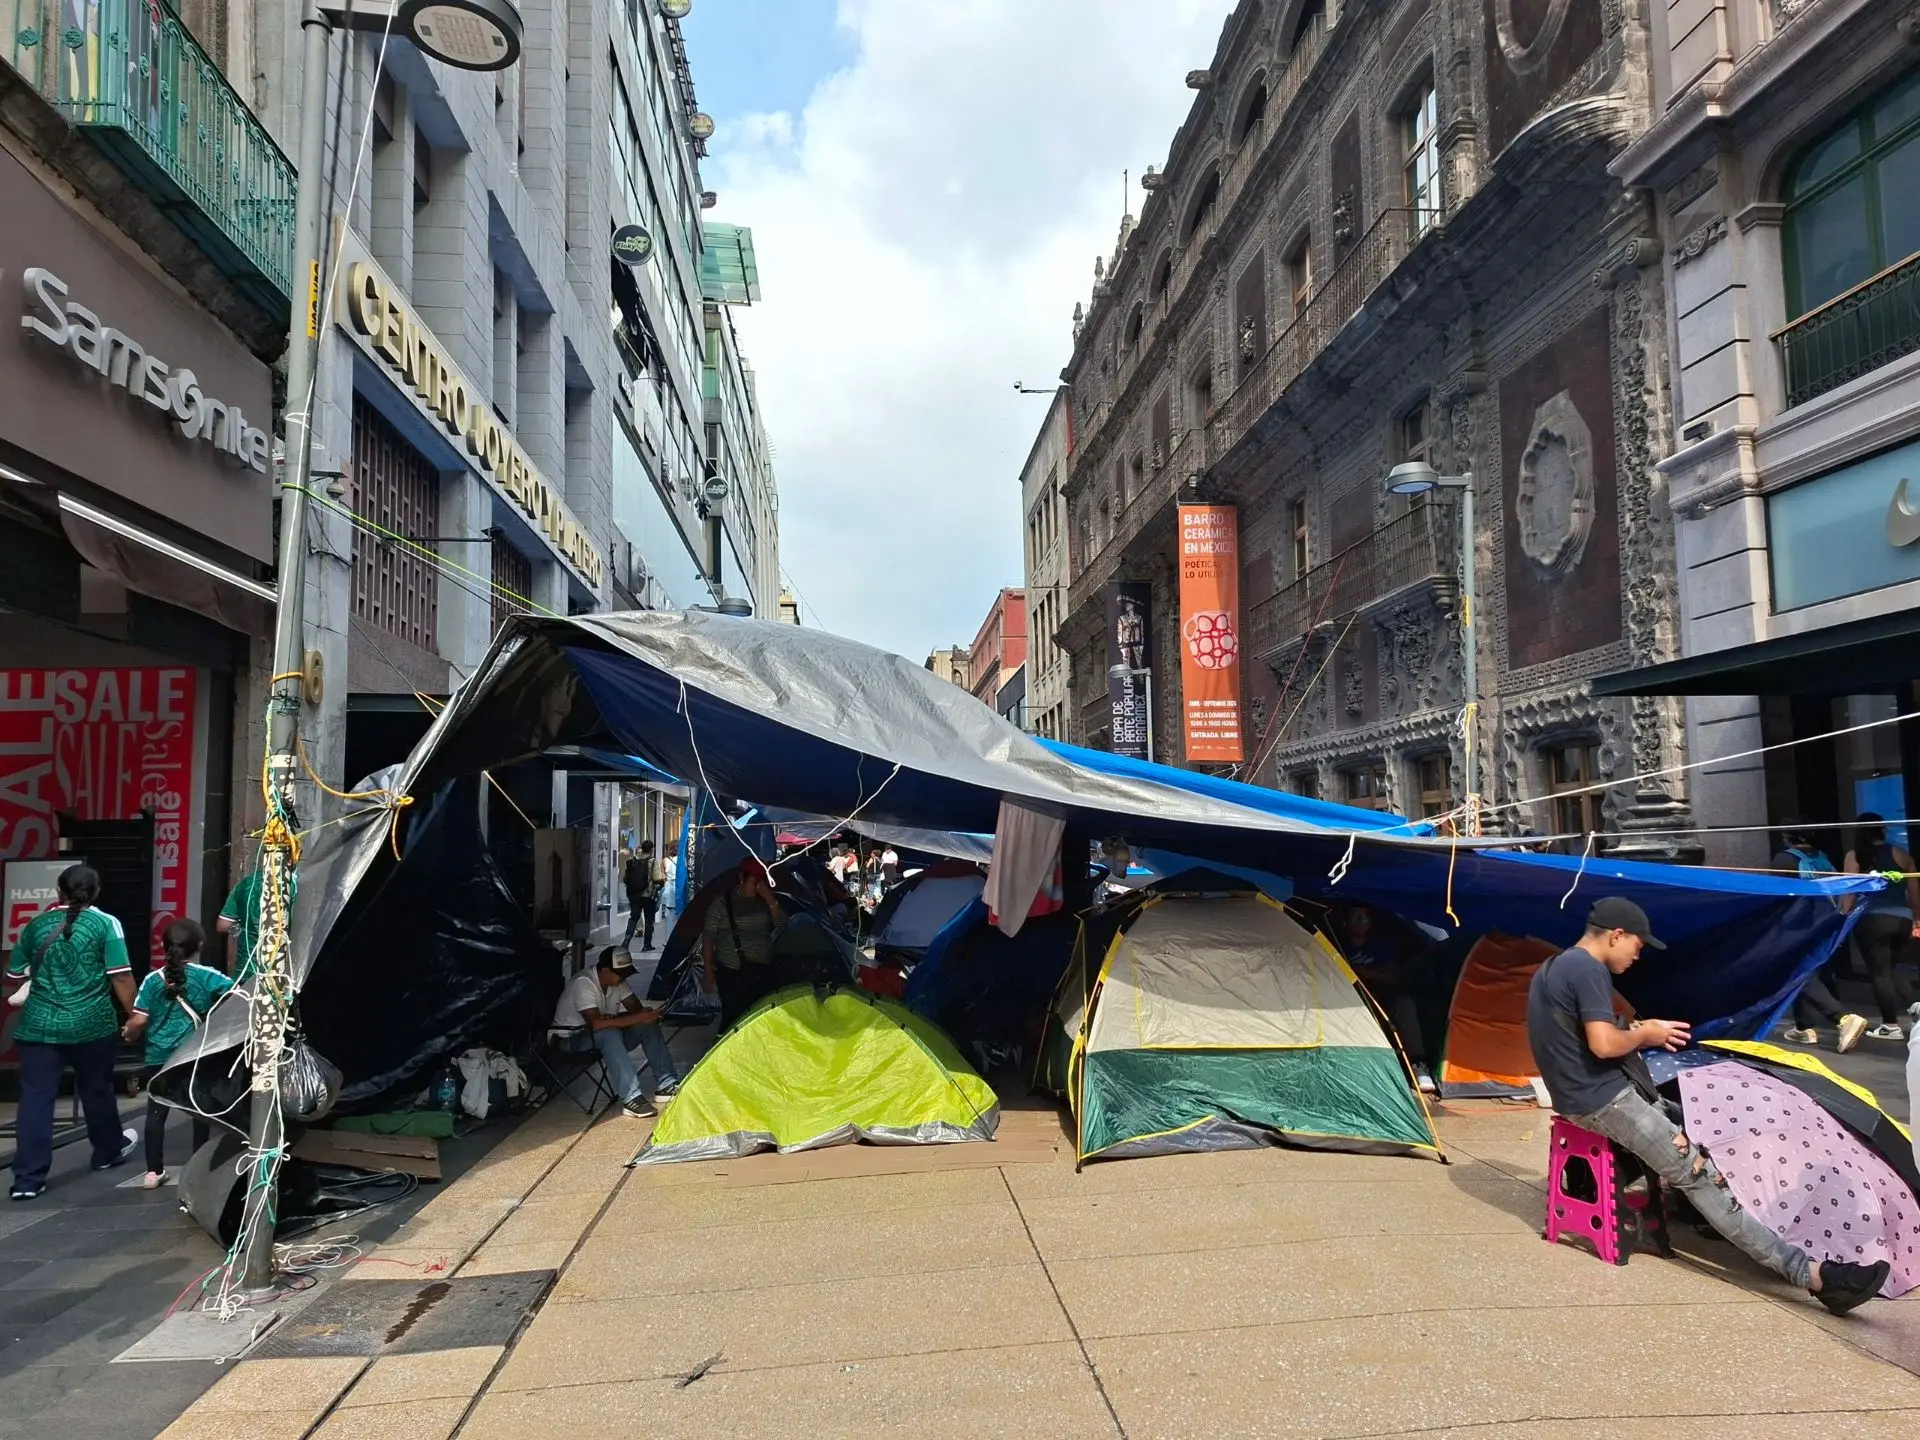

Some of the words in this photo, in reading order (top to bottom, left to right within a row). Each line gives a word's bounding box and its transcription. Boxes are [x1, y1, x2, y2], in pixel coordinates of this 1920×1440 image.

[22, 268, 269, 474] Samsonite
[348, 262, 467, 436] CENTRO
[466, 405, 543, 520] JOYERO
[549, 498, 602, 589] PLATERO
[1184, 513, 1224, 526] BARRO
[1184, 525, 1234, 540] CERÁMICA
[1184, 541, 1198, 554] EN
[1200, 539, 1234, 553] MÉXICO
[1185, 570, 1195, 579] LO
[54, 669, 186, 724] SALE
[304, 650, 324, 705] 6
[1123, 674, 1135, 716] POPULAR
[1112, 701, 1124, 715] DE
[1113, 717, 1124, 743] COPA
[1124, 718, 1135, 743] ARTE
[1135, 694, 1147, 743] BANAMEX
[0, 672, 56, 861] SALE
[52, 722, 137, 826] SALE
[141, 720, 183, 791] Sale
[154, 791, 181, 860] sale
[11, 888, 59, 900] HASTA
